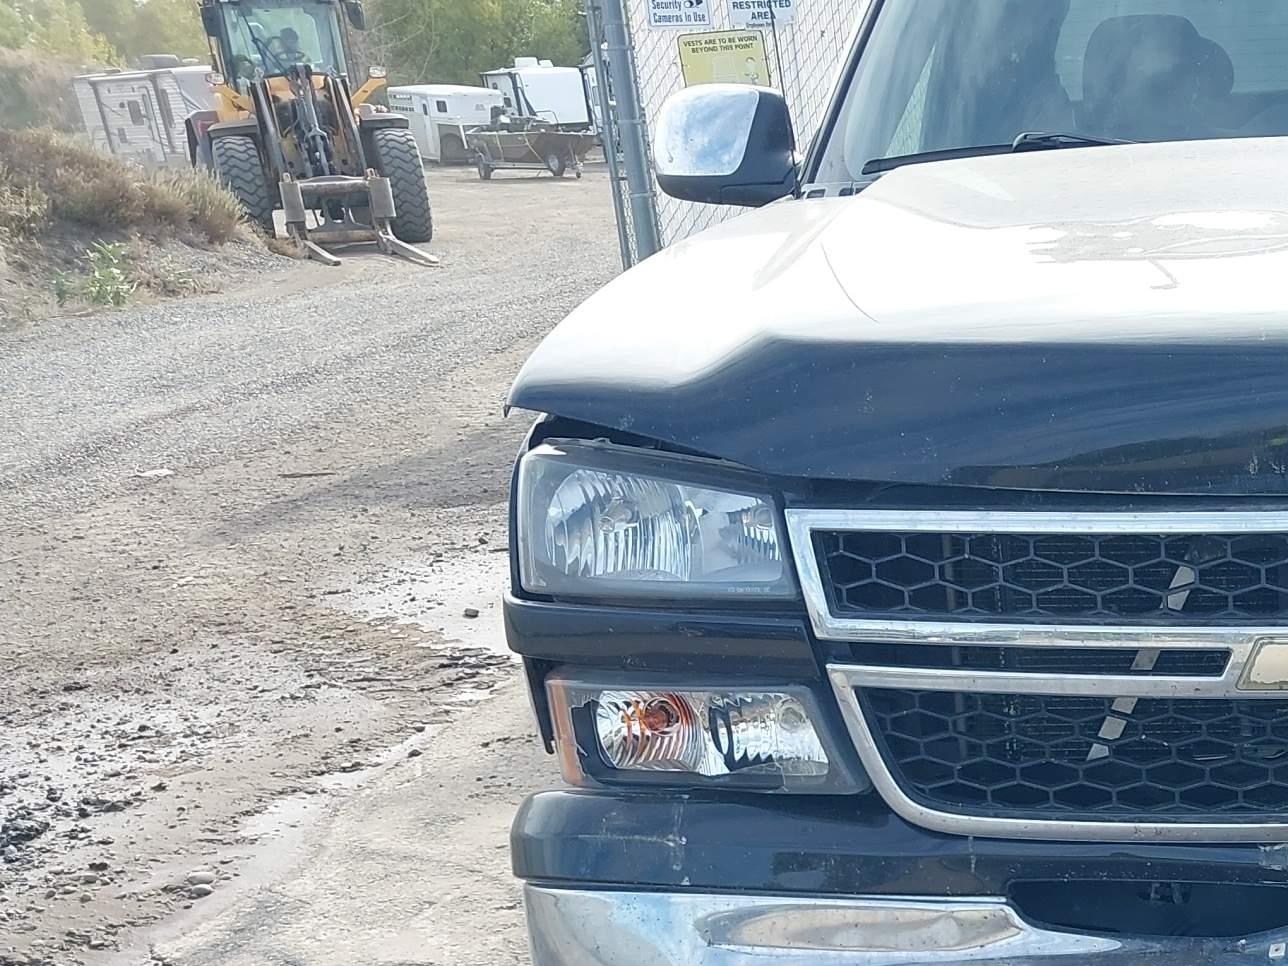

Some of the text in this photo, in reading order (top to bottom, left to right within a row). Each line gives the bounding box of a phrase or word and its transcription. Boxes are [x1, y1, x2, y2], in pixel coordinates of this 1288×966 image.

[652, 0, 682, 11] Security
[732, 0, 792, 10] RESTRICTED
[653, 11, 706, 23] Cameras In Use
[691, 46, 718, 54] BEYOND
